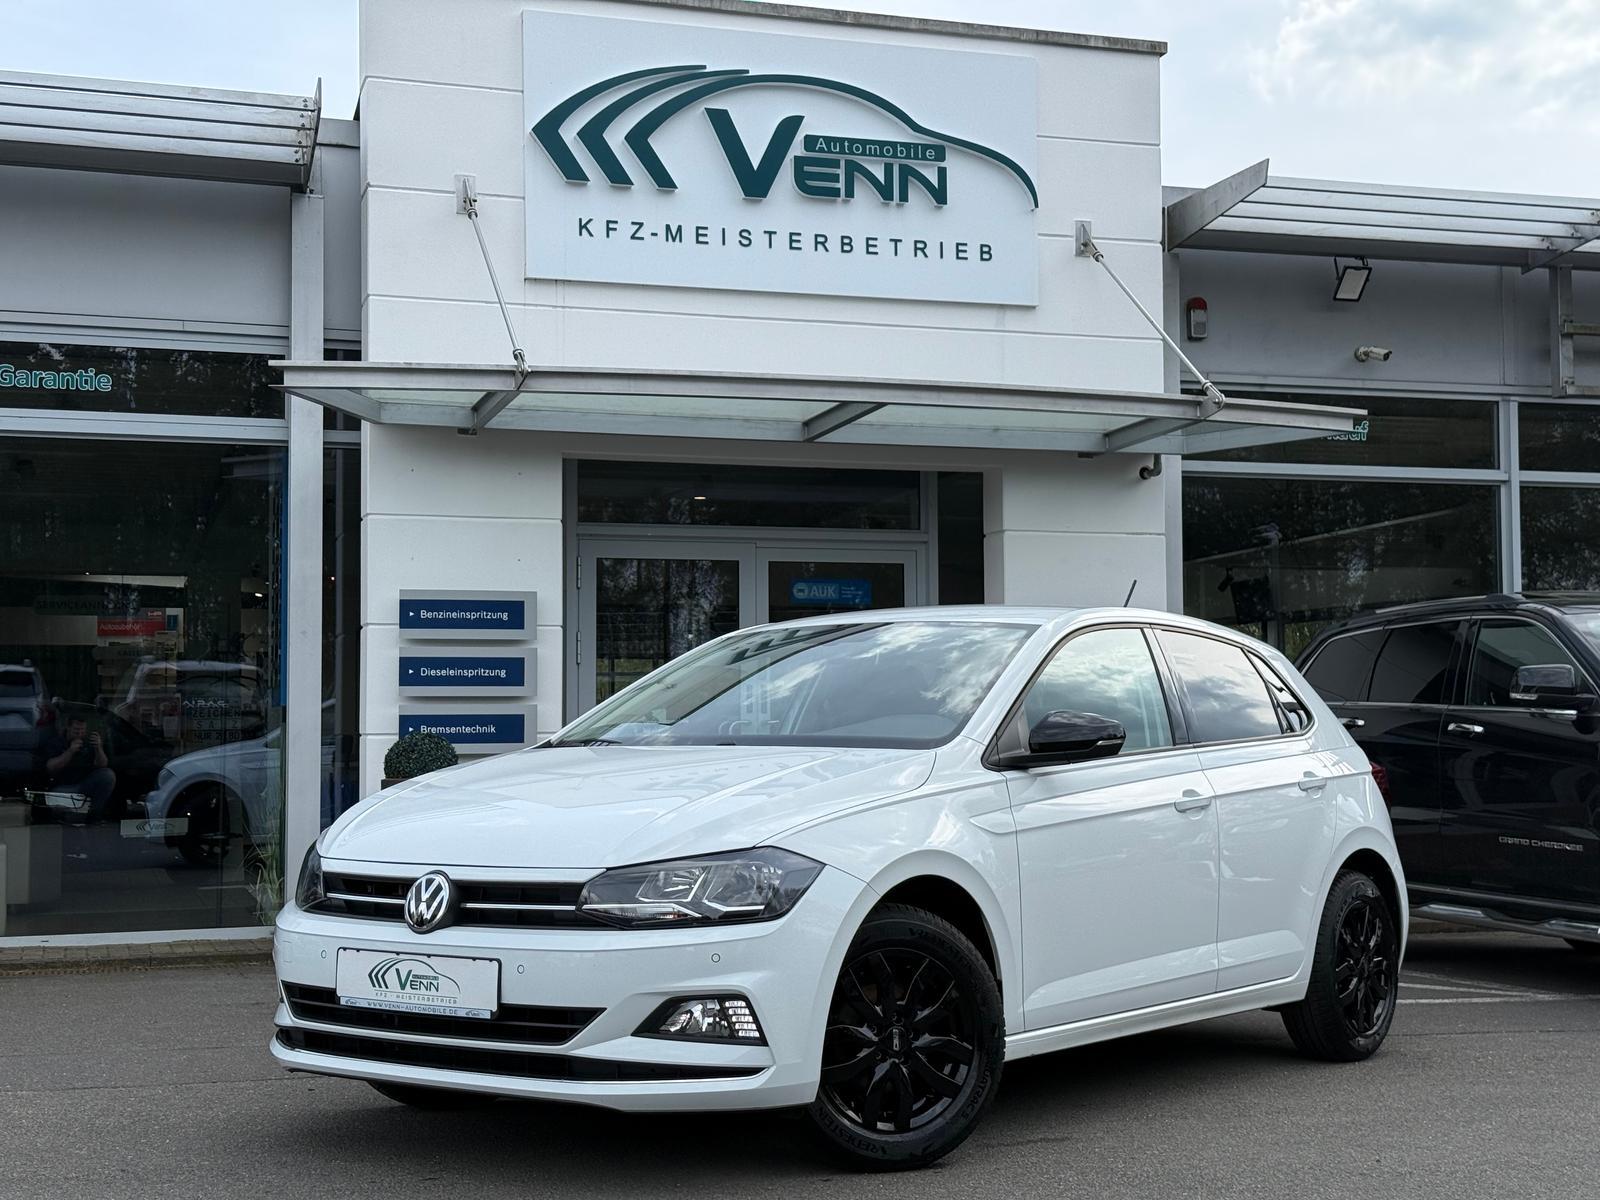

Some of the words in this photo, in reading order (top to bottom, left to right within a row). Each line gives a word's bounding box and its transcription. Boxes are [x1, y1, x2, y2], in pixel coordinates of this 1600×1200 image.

[814, 136, 937, 161] Automobile
[578, 217, 994, 262] KFZ-MEISTERBETRIEB
[0, 364, 113, 391] Garantie
[810, 584, 836, 598] AUK
[420, 609, 509, 621] Benzineinspritzung
[420, 667, 507, 678] Dieseleinspritzung
[420, 724, 496, 734] Bremsentechnik
